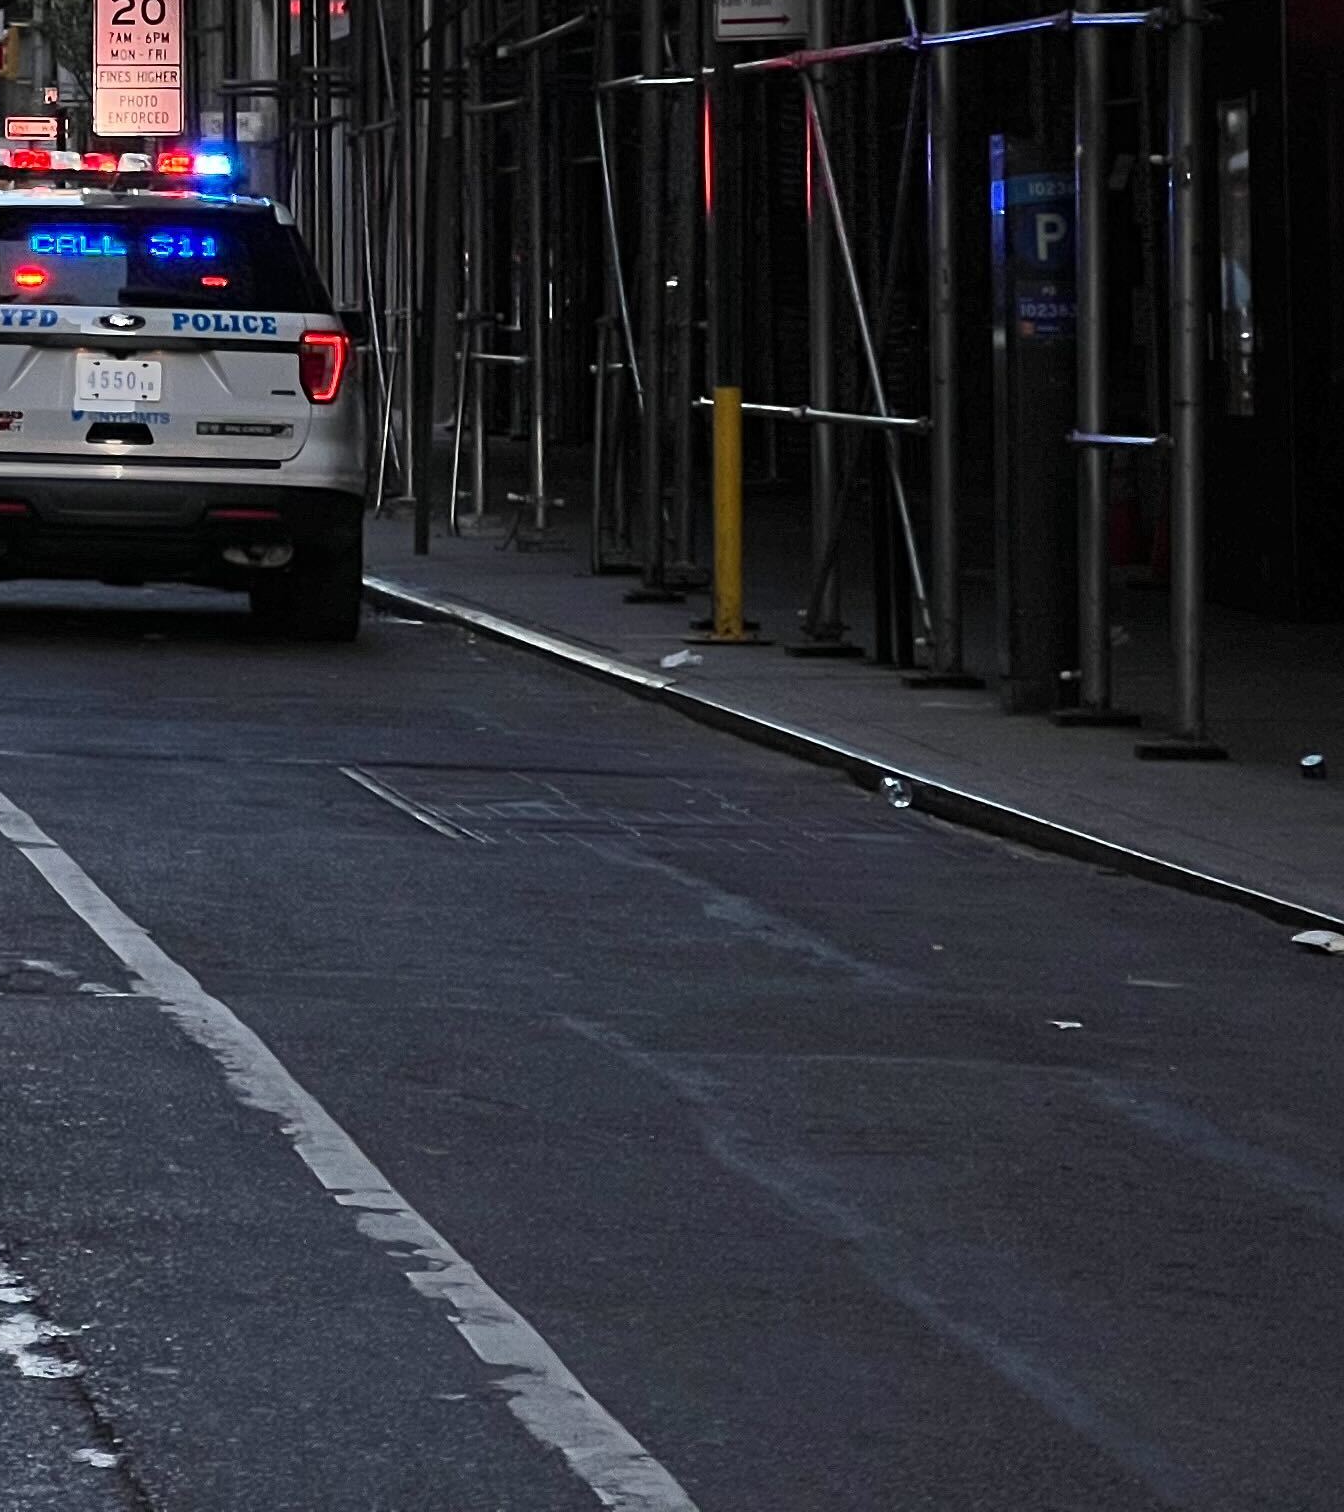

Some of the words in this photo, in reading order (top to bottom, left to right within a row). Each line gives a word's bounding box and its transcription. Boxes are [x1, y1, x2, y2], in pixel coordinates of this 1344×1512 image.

[108, 31, 133, 44] 7AM
[144, 31, 170, 44] 6PM
[110, 49, 136, 60] MON
[148, 48, 167, 60] FRI
[99, 70, 132, 83] FINES
[137, 70, 178, 83] HIGHER
[119, 95, 159, 108] PHOTO
[108, 111, 170, 124] ENFORCED
[31, 234, 128, 255] CALL
[171, 312, 278, 335] POLICE
[87, 371, 136, 391] 4550
